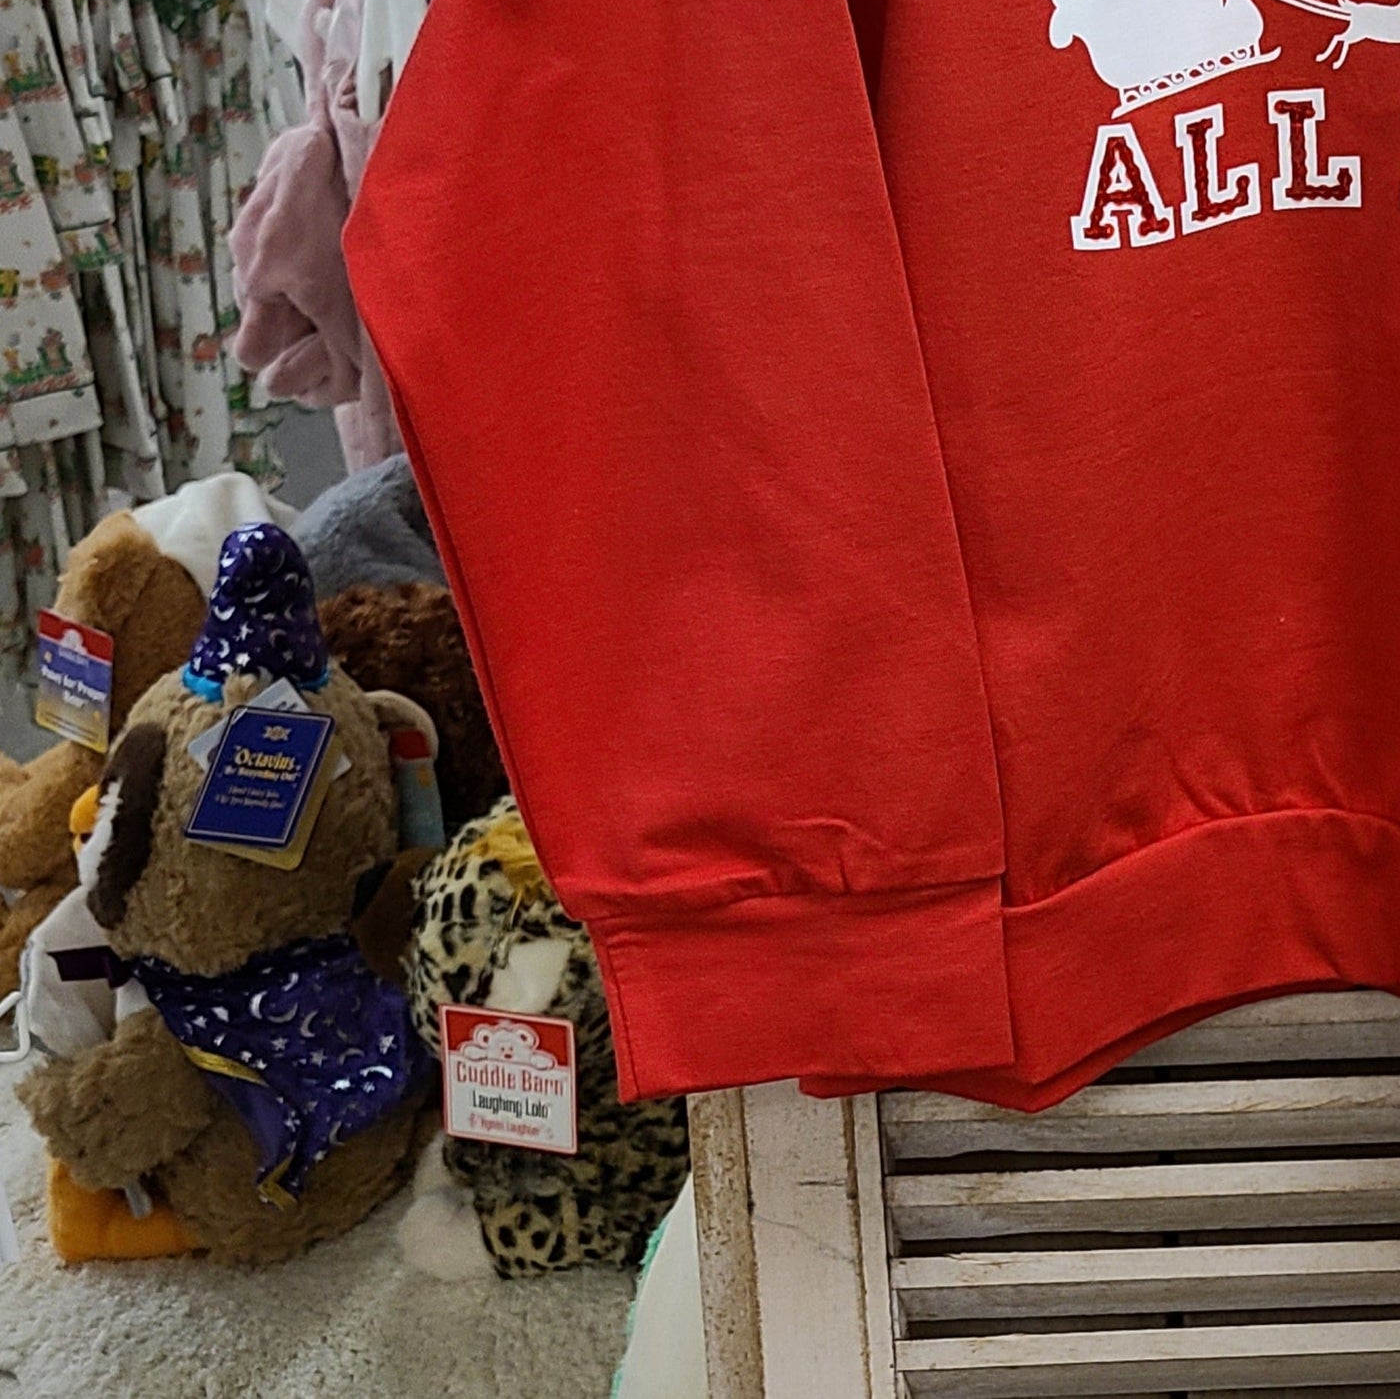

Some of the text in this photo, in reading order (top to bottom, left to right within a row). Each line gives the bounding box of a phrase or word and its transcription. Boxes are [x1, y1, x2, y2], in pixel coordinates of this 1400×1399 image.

[1070, 88, 1361, 251] ALL
[456, 1060, 564, 1098] Cuddle Barn
[472, 1089, 549, 1119] Laughing Lolo
